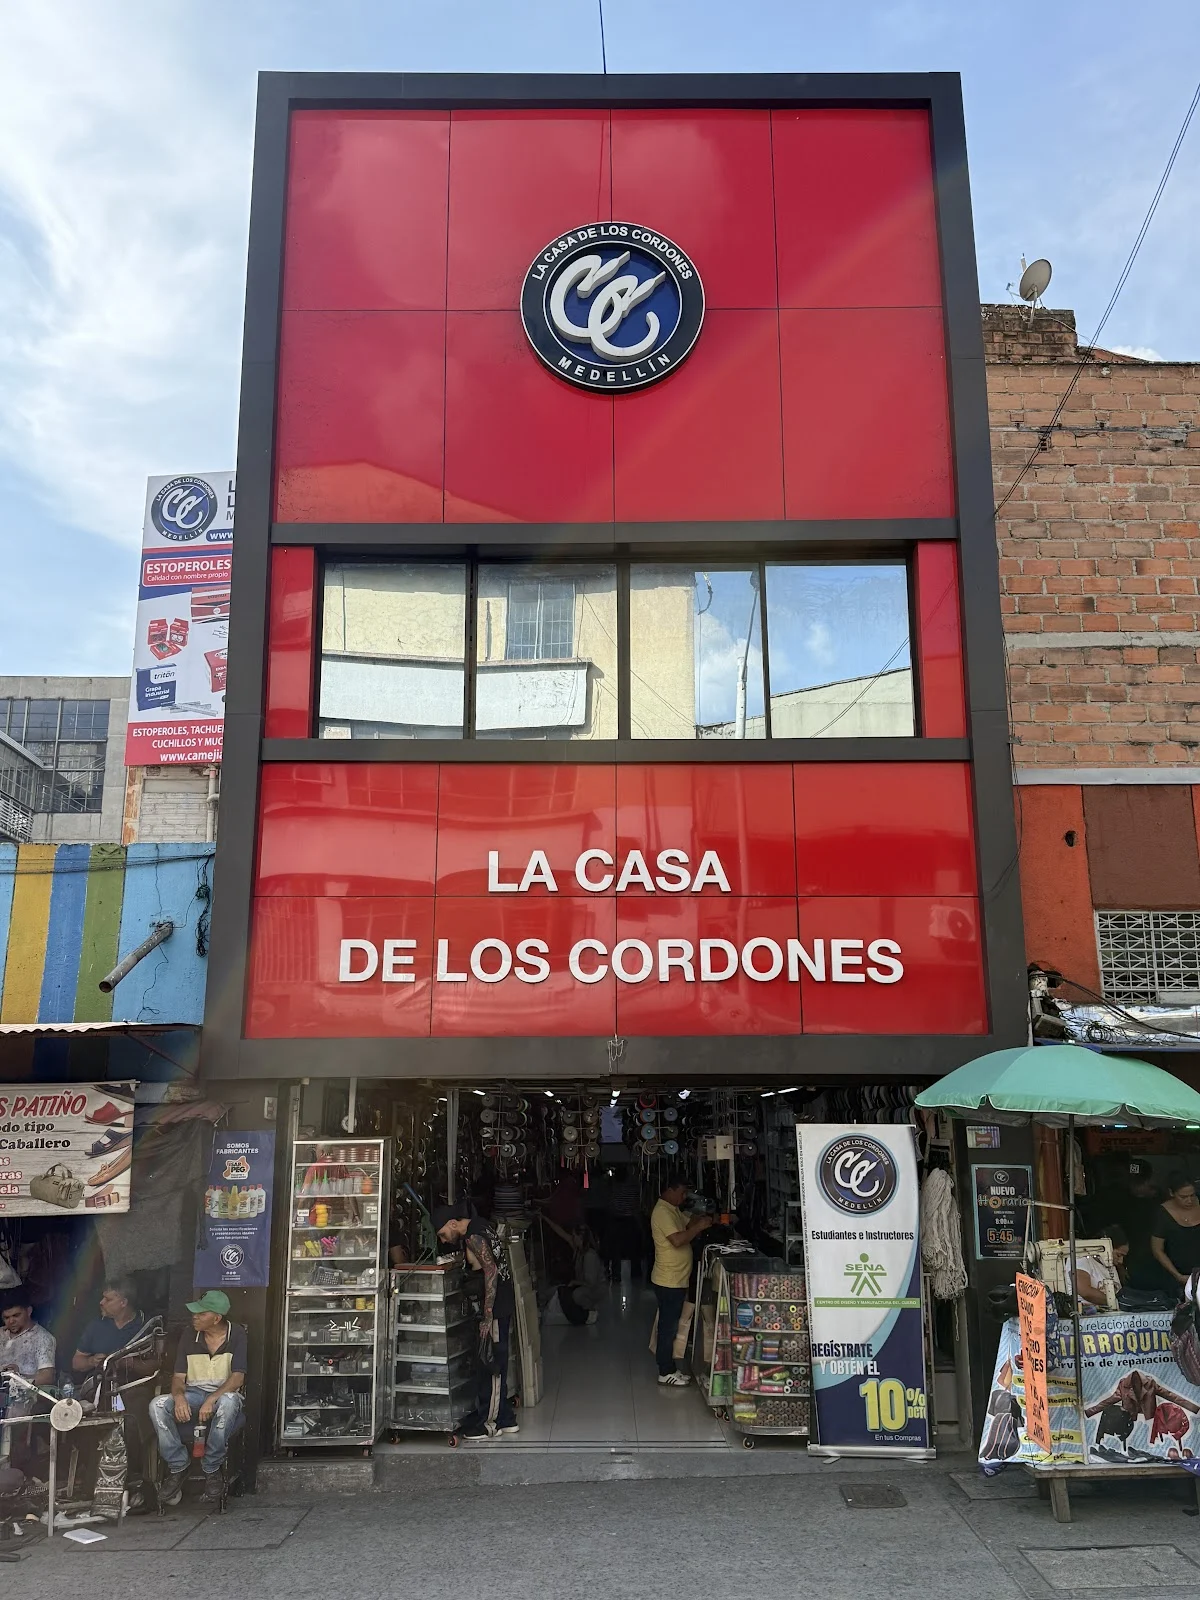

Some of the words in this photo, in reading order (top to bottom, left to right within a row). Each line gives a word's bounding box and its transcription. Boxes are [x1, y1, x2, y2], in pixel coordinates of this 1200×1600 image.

[532, 263, 549, 281] LA
[543, 237, 578, 263] CASA
[577, 227, 598, 242] DE
[600, 225, 629, 237] LOS
[631, 229, 693, 280] CORDONES
[557, 353, 671, 382] MEDELLÍN
[156, 494, 163, 502] LA
[161, 482, 174, 495] CASA
[193, 478, 216, 499] CORDONES
[146, 559, 231, 574] ESTOPEROLES
[147, 574, 169, 582] Calidad
[183, 572, 207, 580] nombre
[132, 726, 190, 737] ESTOPEROLES,
[152, 738, 197, 749] CUCHILLOS
[197, 738, 203, 746] Y
[488, 850, 559, 892] LA
[574, 848, 731, 892] CASA
[338, 938, 417, 983] DE
[436, 937, 550, 984] LOS
[568, 936, 904, 984] CORDONES
[10, 1090, 87, 1117] PATIÑO
[0, 1121, 20, 1133] do
[24, 1121, 55, 1134] tipo
[0, 1138, 71, 1150] Caballero
[826, 1156, 833, 1164] LA
[830, 1143, 843, 1157] CASA
[863, 1140, 890, 1165] CORDONES
[990, 1186, 1016, 1196] NUEVO
[811, 1230, 857, 1241] Estudiantes
[859, 1232, 864, 1240] e
[865, 1230, 914, 1240] Instructores
[988, 1229, 1014, 1242] 5:45
[845, 1263, 885, 1271] SENA
[1086, 1318, 1149, 1331] relacionado
[1152, 1319, 1172, 1327] con
[812, 1340, 873, 1358] REGÍSTRATE
[820, 1360, 827, 1375] Y
[830, 1358, 865, 1375] OBTÉN
[867, 1360, 880, 1375] EL
[1099, 1358, 1113, 1368] de
[894, 1434, 922, 1442] Compras
